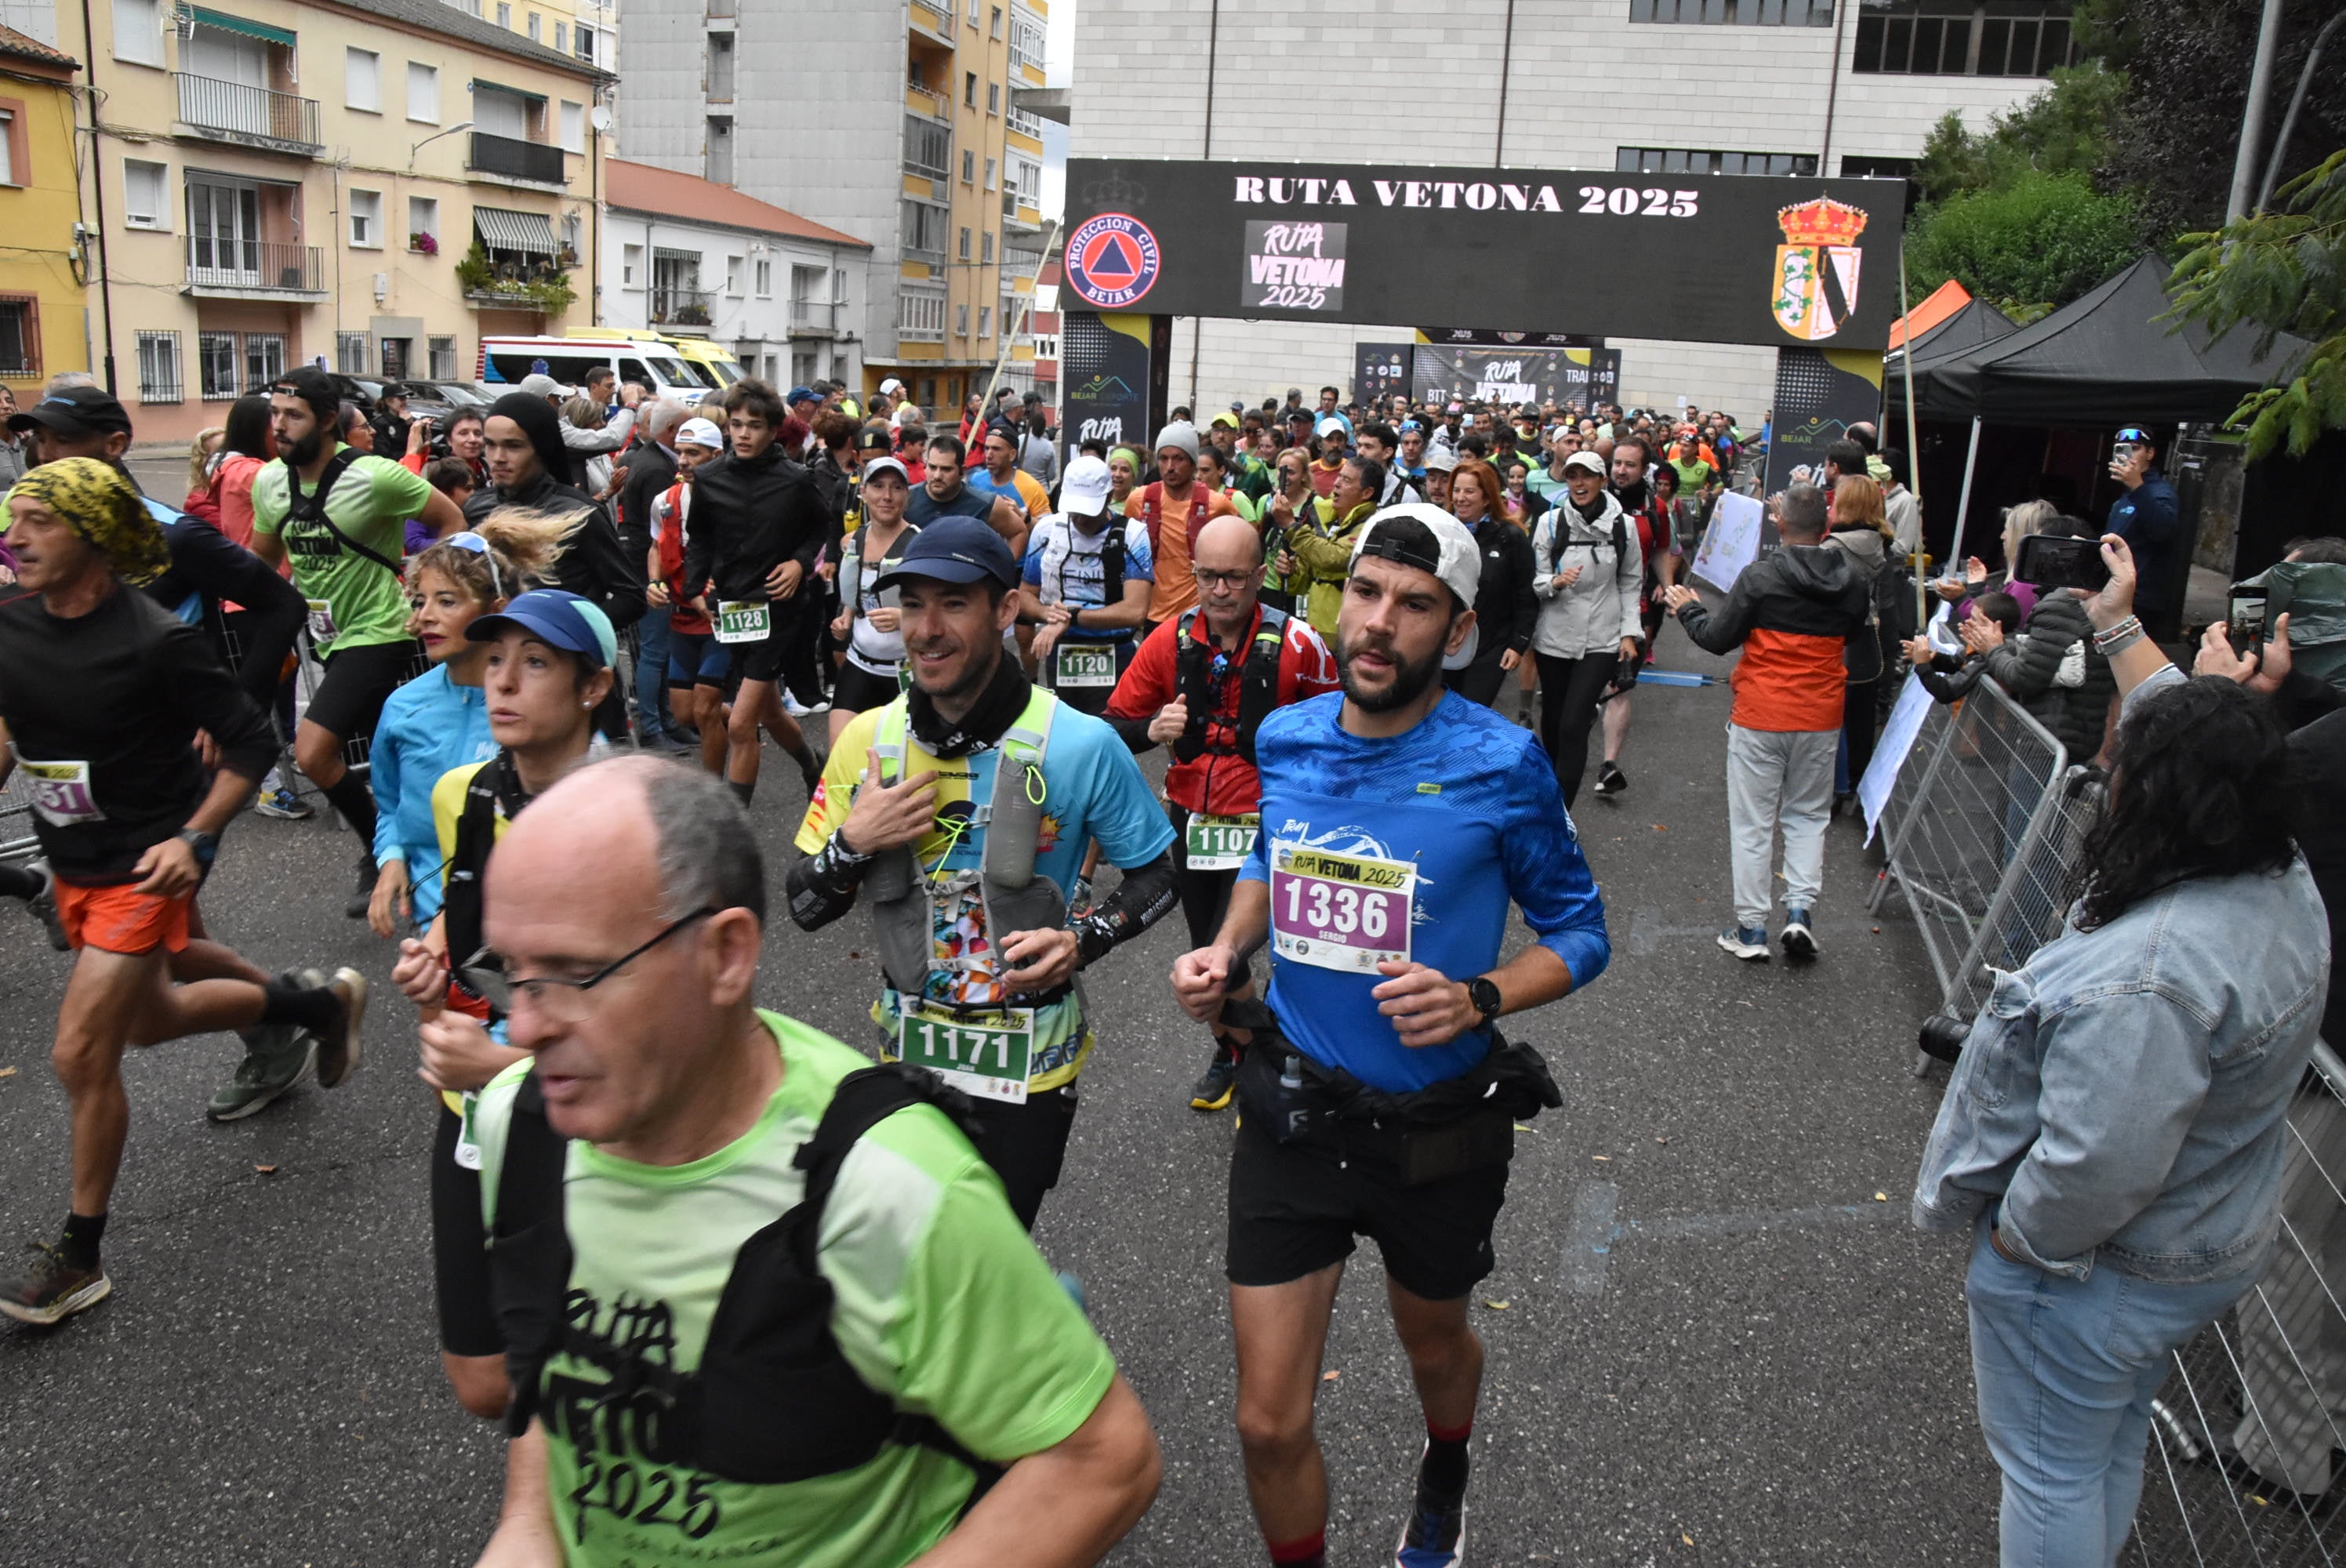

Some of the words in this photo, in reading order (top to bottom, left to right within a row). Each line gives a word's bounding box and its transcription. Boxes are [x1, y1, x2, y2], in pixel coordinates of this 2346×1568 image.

[1234, 176, 1358, 205] RUTA
[1371, 180, 1564, 212] VETONA
[1578, 186, 1699, 218] 2025
[1070, 218, 1133, 270] PROTECCION
[1137, 234, 1156, 274] CIVIL
[1263, 222, 1324, 258] RUTA
[1251, 255, 1346, 288] VETONA
[1258, 285, 1326, 310] 2025
[1485, 360, 1521, 383] RUTA
[1427, 389, 1447, 402] BTT
[1080, 416, 1122, 444] RUTA
[1781, 434, 1811, 444] BEJAR
[301, 556, 336, 572] 2025
[727, 611, 763, 629] 1128
[1066, 655, 1107, 673] 1120
[1199, 827, 1258, 851] 1107
[1295, 855, 1316, 873] RUTA
[1317, 858, 1361, 880] VETONA
[1364, 867, 1407, 889] 2025
[1285, 878, 1389, 938] 1336
[1318, 930, 1348, 945] SERGIO
[918, 1023, 1008, 1069] 1171
[570, 1462, 721, 1539] 2025
